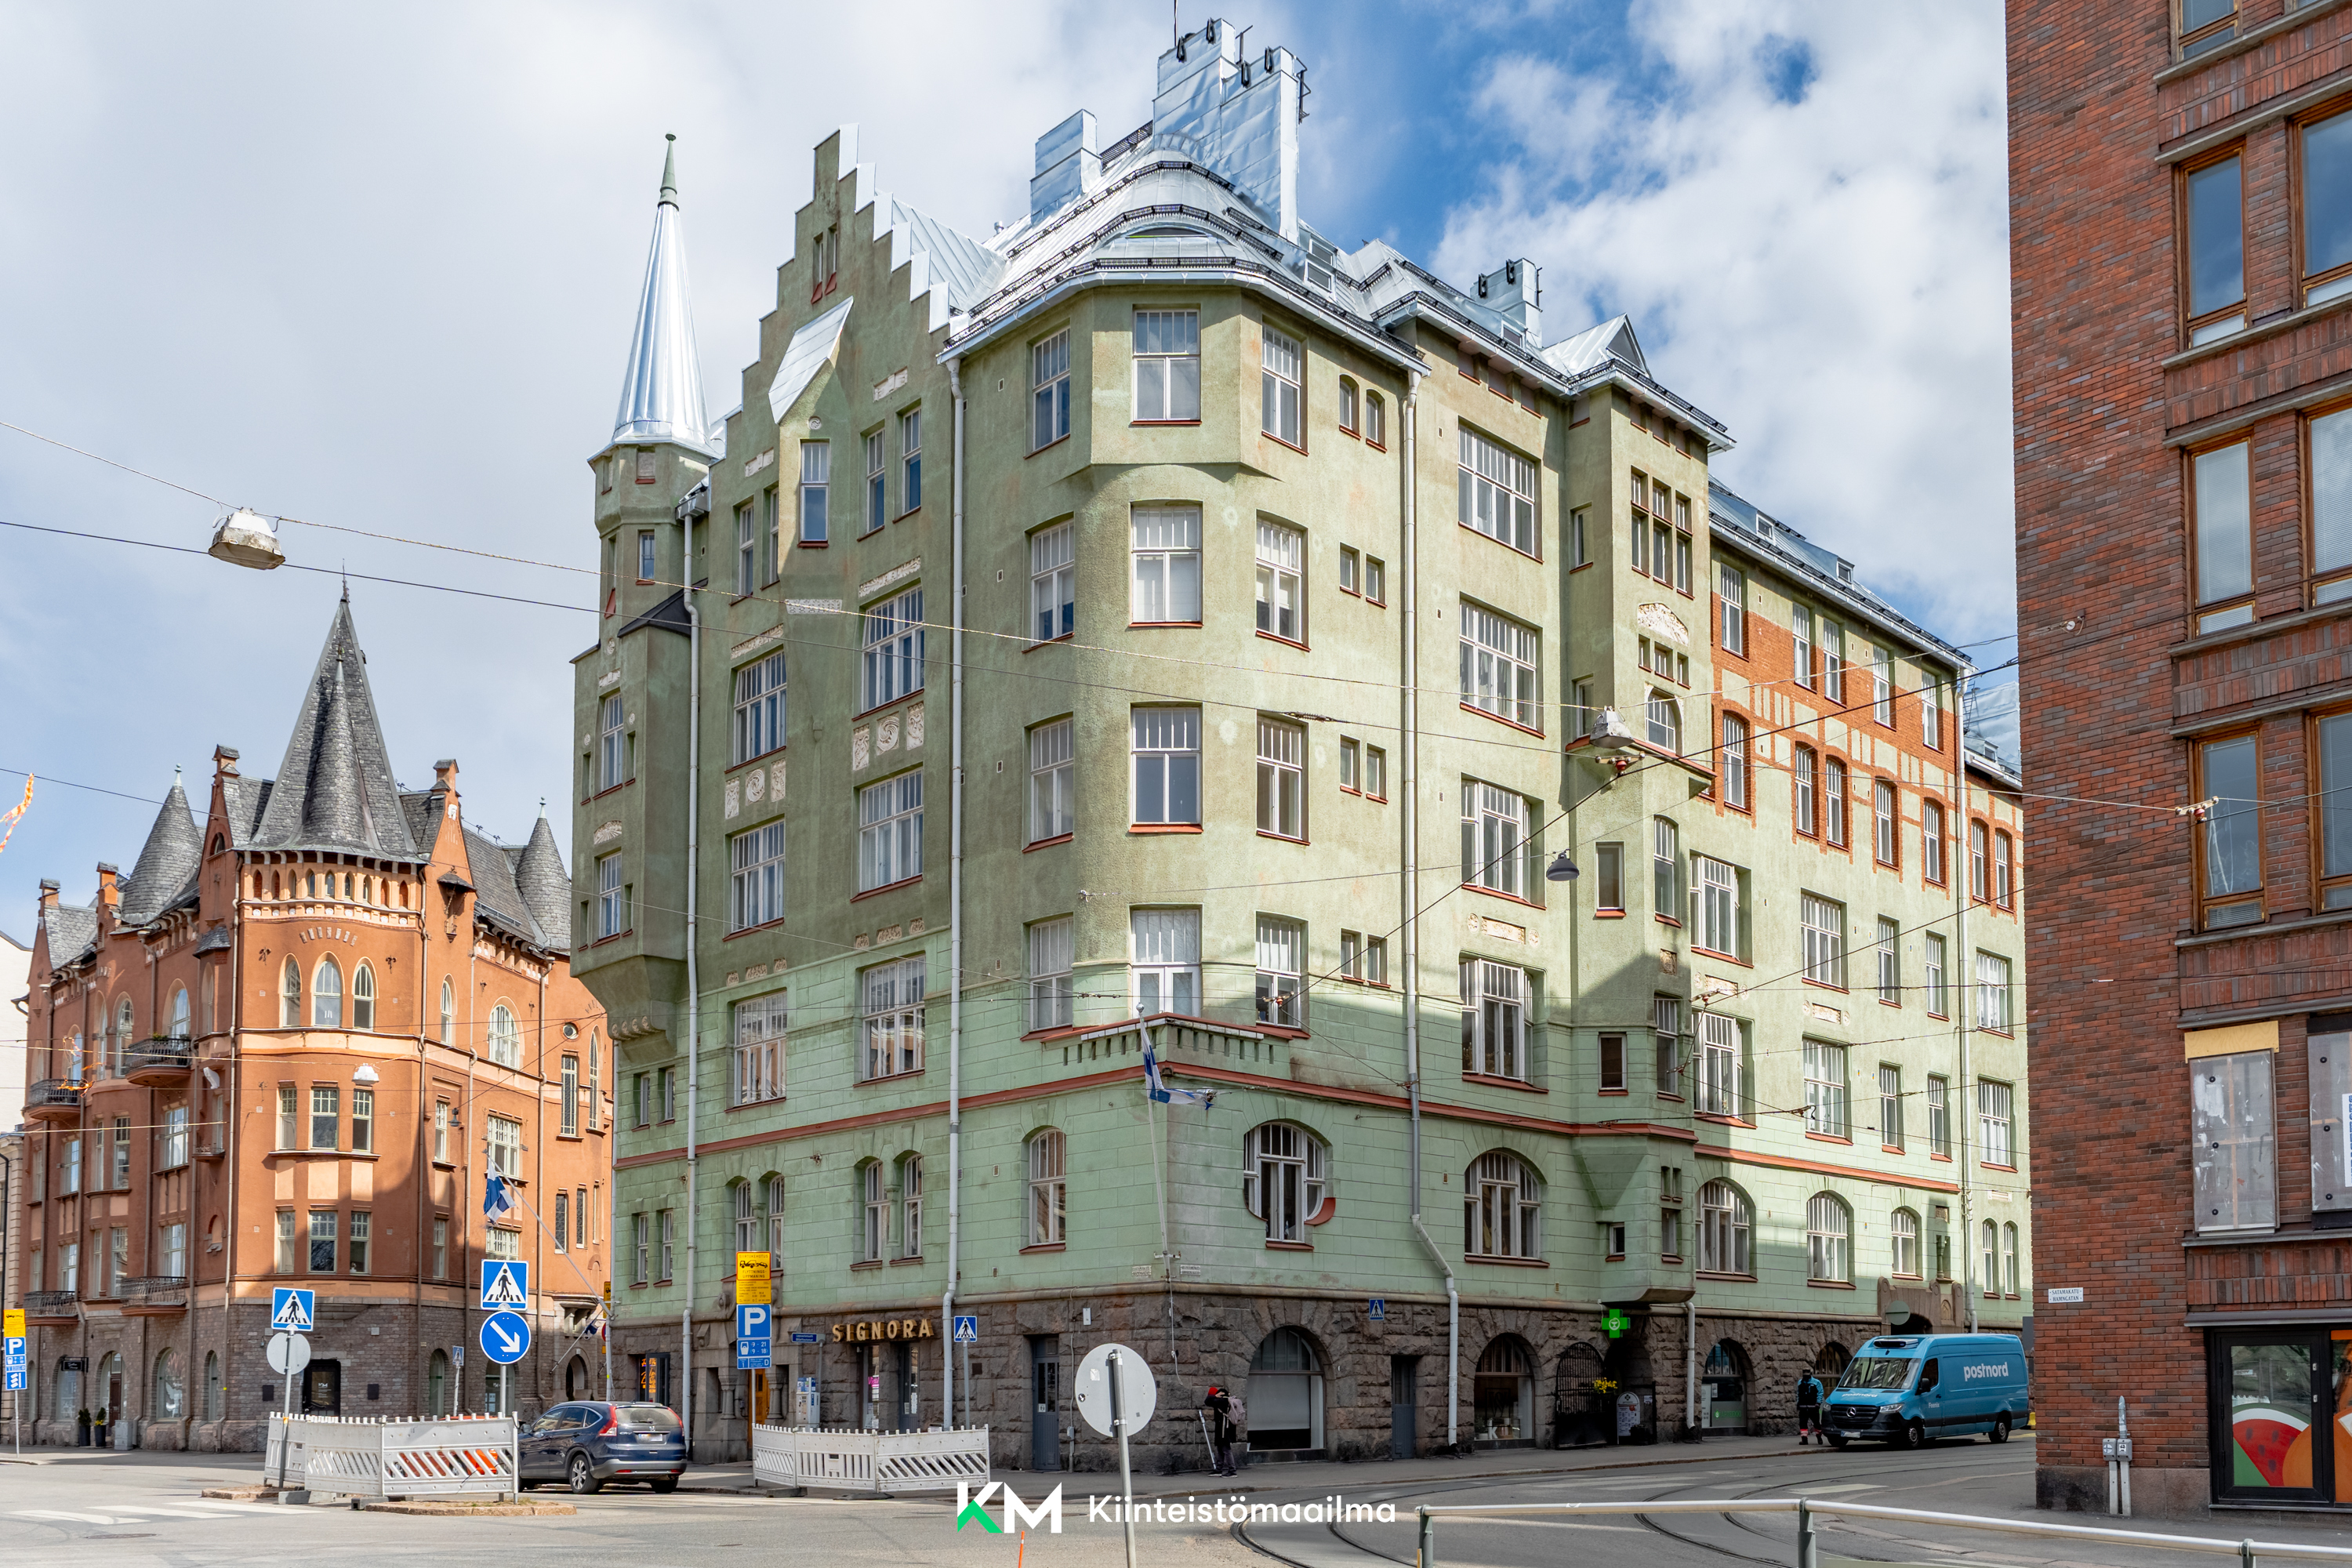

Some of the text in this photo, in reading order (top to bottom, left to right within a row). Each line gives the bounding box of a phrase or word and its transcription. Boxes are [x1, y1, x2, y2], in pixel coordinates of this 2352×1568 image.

[745, 1307, 766, 1335] P
[832, 1319, 934, 1342] SIGNORA
[9, 1338, 23, 1354] P
[1963, 1361, 2009, 1381] postnord
